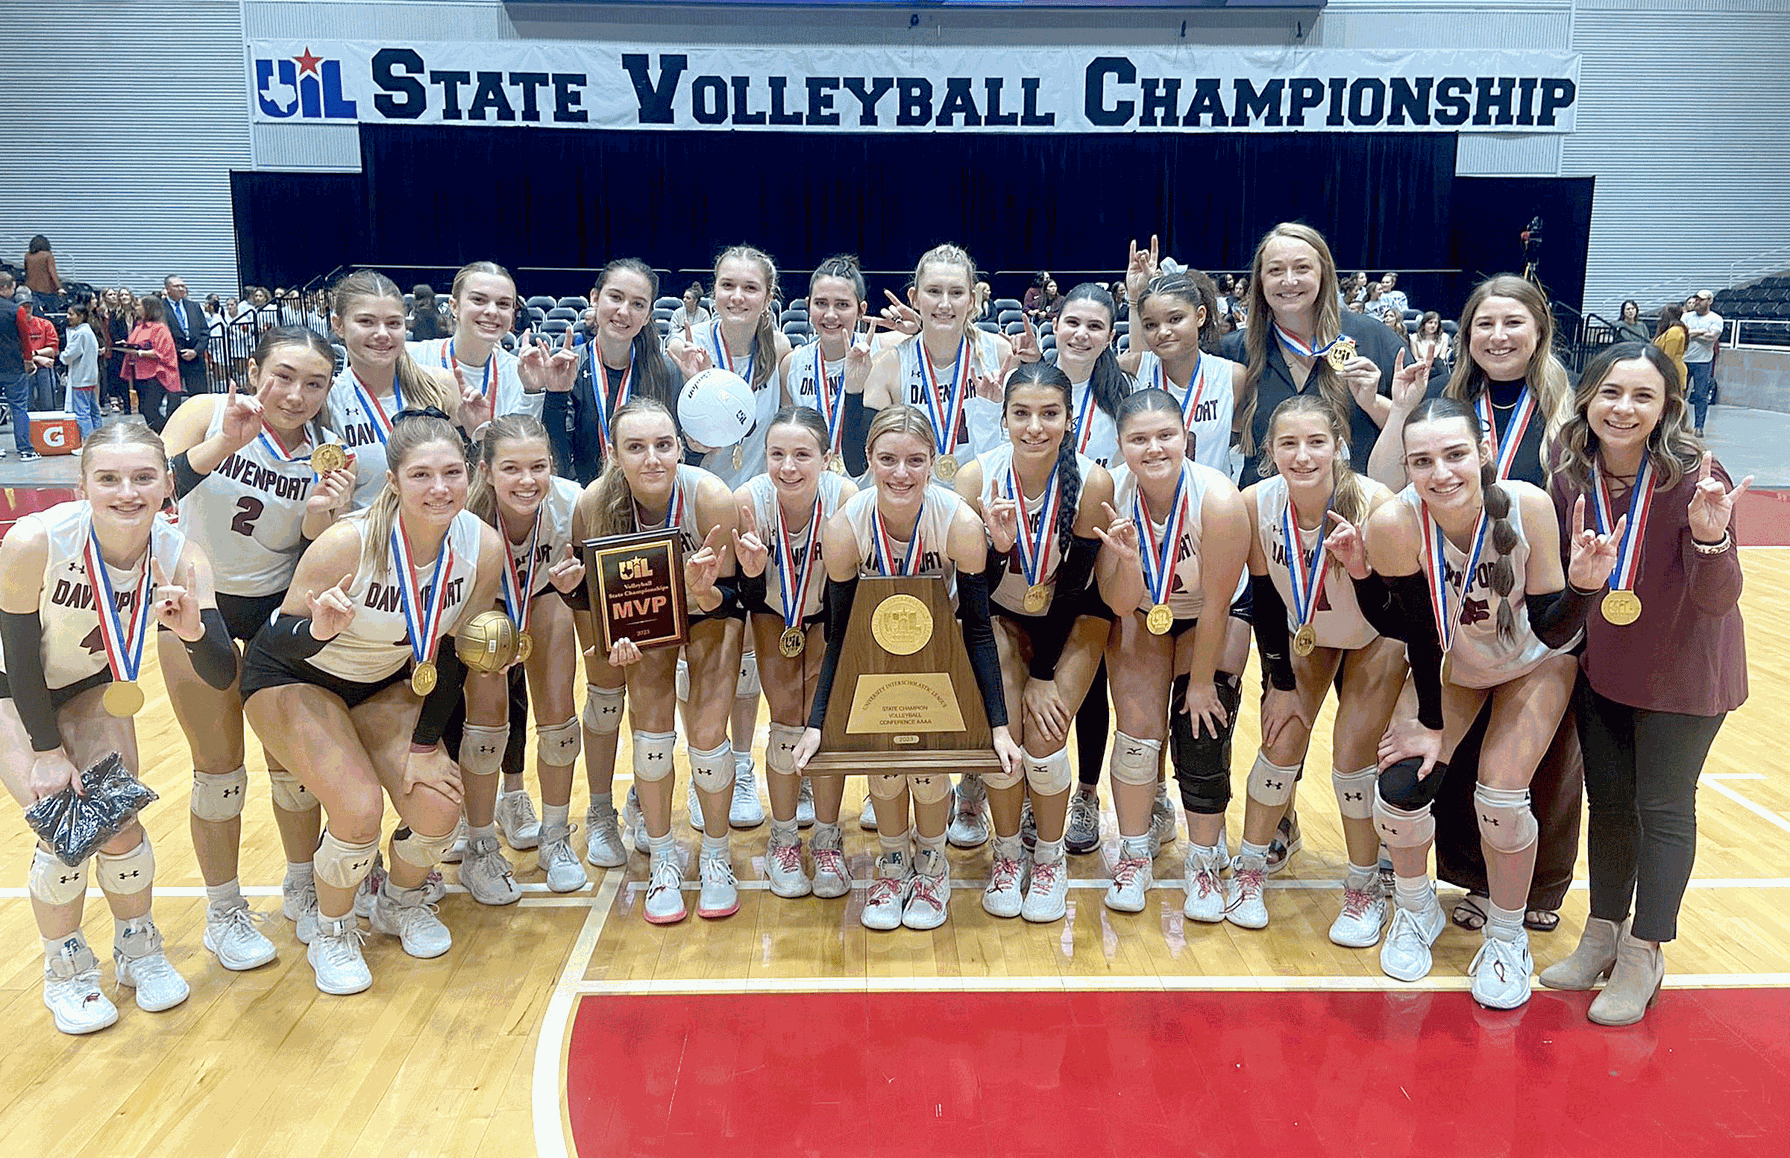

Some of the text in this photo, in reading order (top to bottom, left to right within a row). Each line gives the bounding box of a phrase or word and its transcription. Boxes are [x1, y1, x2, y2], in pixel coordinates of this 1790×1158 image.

[371, 47, 589, 123] STATE
[621, 53, 1055, 127] VOLLEYBALL
[1084, 56, 1575, 127] CHAMPIONSHIP
[43, 426, 65, 448] G
[214, 454, 311, 501] AVENPORT
[230, 496, 264, 537] 2
[624, 580, 652, 590] Volleyball
[624, 585, 669, 597] Championships
[612, 596, 667, 620] MVP
[862, 680, 948, 711] UNIVERSITY INTERSCHOLASTIC LEAGUE
